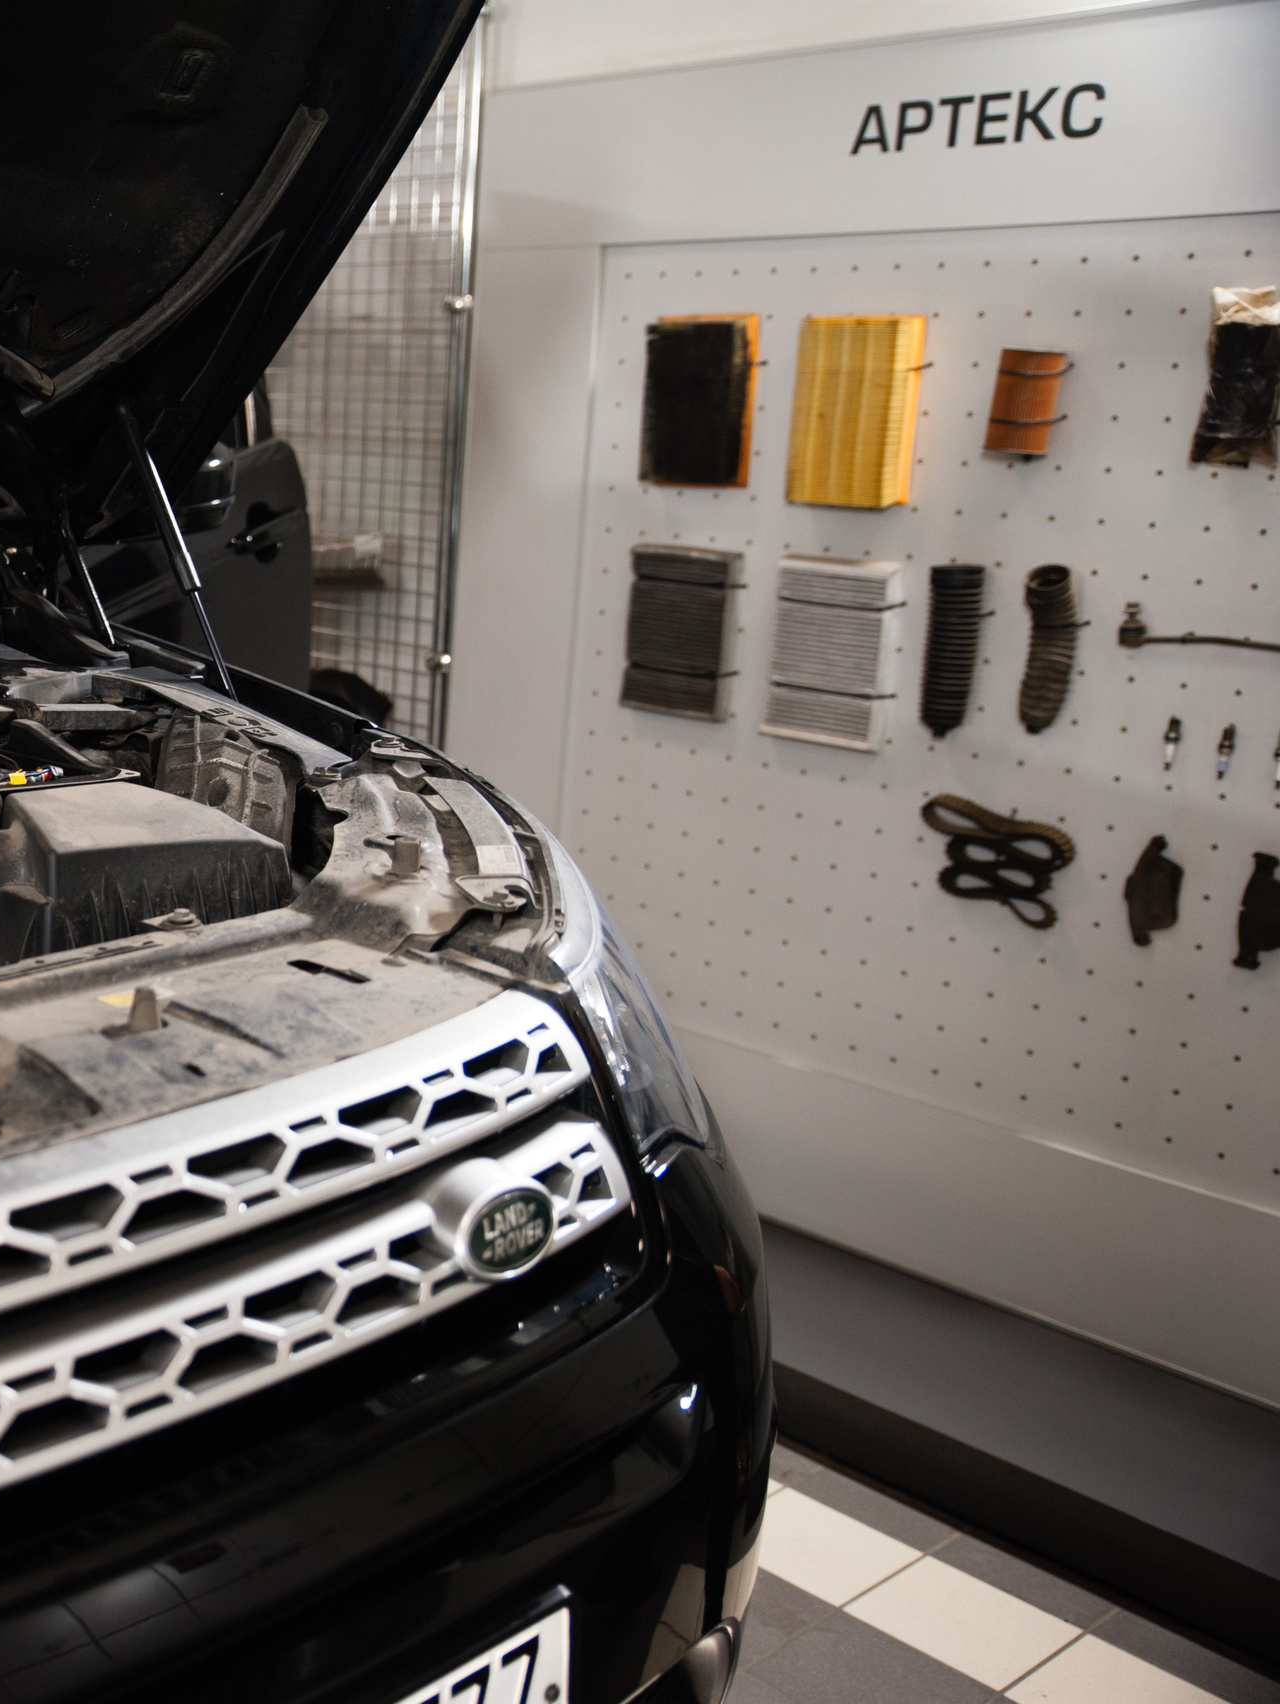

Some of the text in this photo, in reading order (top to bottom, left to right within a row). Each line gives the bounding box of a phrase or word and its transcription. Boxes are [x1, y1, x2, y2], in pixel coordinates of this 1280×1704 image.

[849, 83, 1106, 156] АРТЕКС
[482, 1201, 528, 1241] LAND
[494, 1218, 545, 1262] ROVER
